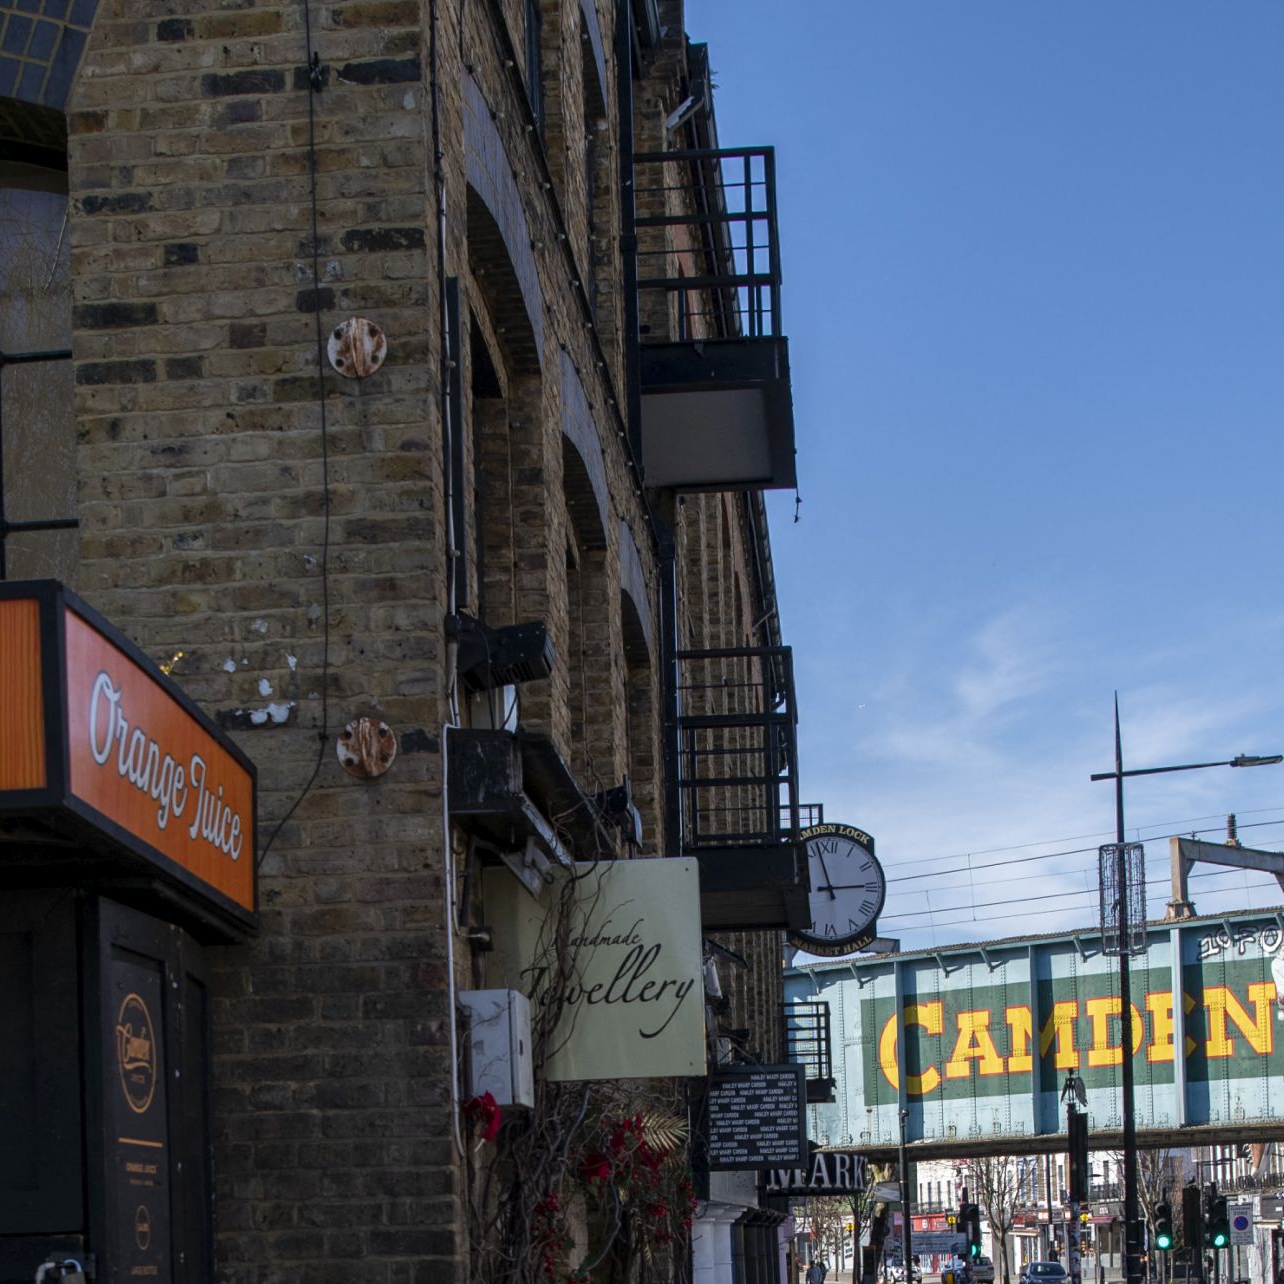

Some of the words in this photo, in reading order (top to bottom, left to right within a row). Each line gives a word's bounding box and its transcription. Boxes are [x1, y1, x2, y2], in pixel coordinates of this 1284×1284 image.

[90, 671, 187, 829] Orange
[190, 754, 243, 861] Juice
[800, 825, 836, 840] MDEN
[839, 827, 870, 845] LOCK
[843, 935, 872, 953] HALL
[879, 981, 1276, 1096] CAMDEN
